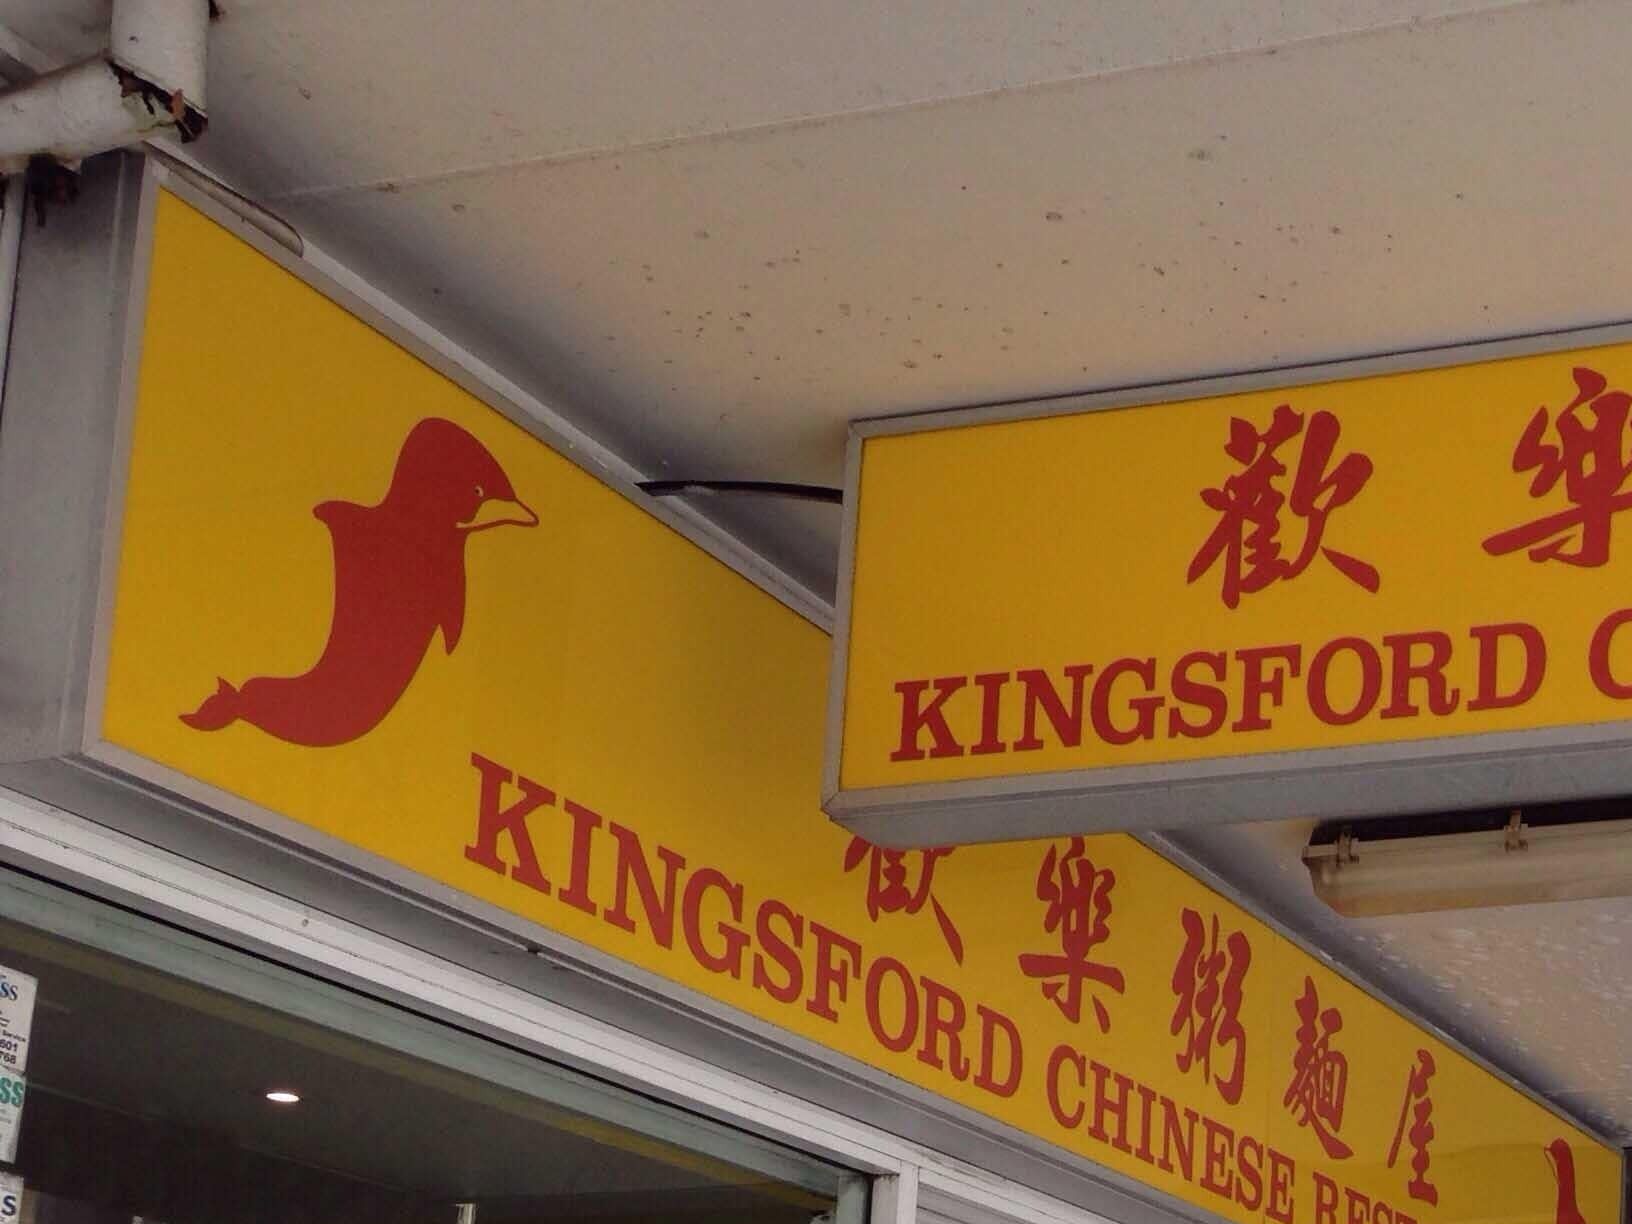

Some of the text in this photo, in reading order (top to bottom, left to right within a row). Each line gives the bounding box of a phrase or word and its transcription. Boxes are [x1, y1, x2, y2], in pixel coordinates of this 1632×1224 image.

[890, 622, 1546, 762] KINGSFORD
[464, 752, 1023, 1100] KINGSFORD
[1046, 1043, 1297, 1224] CHINESE
